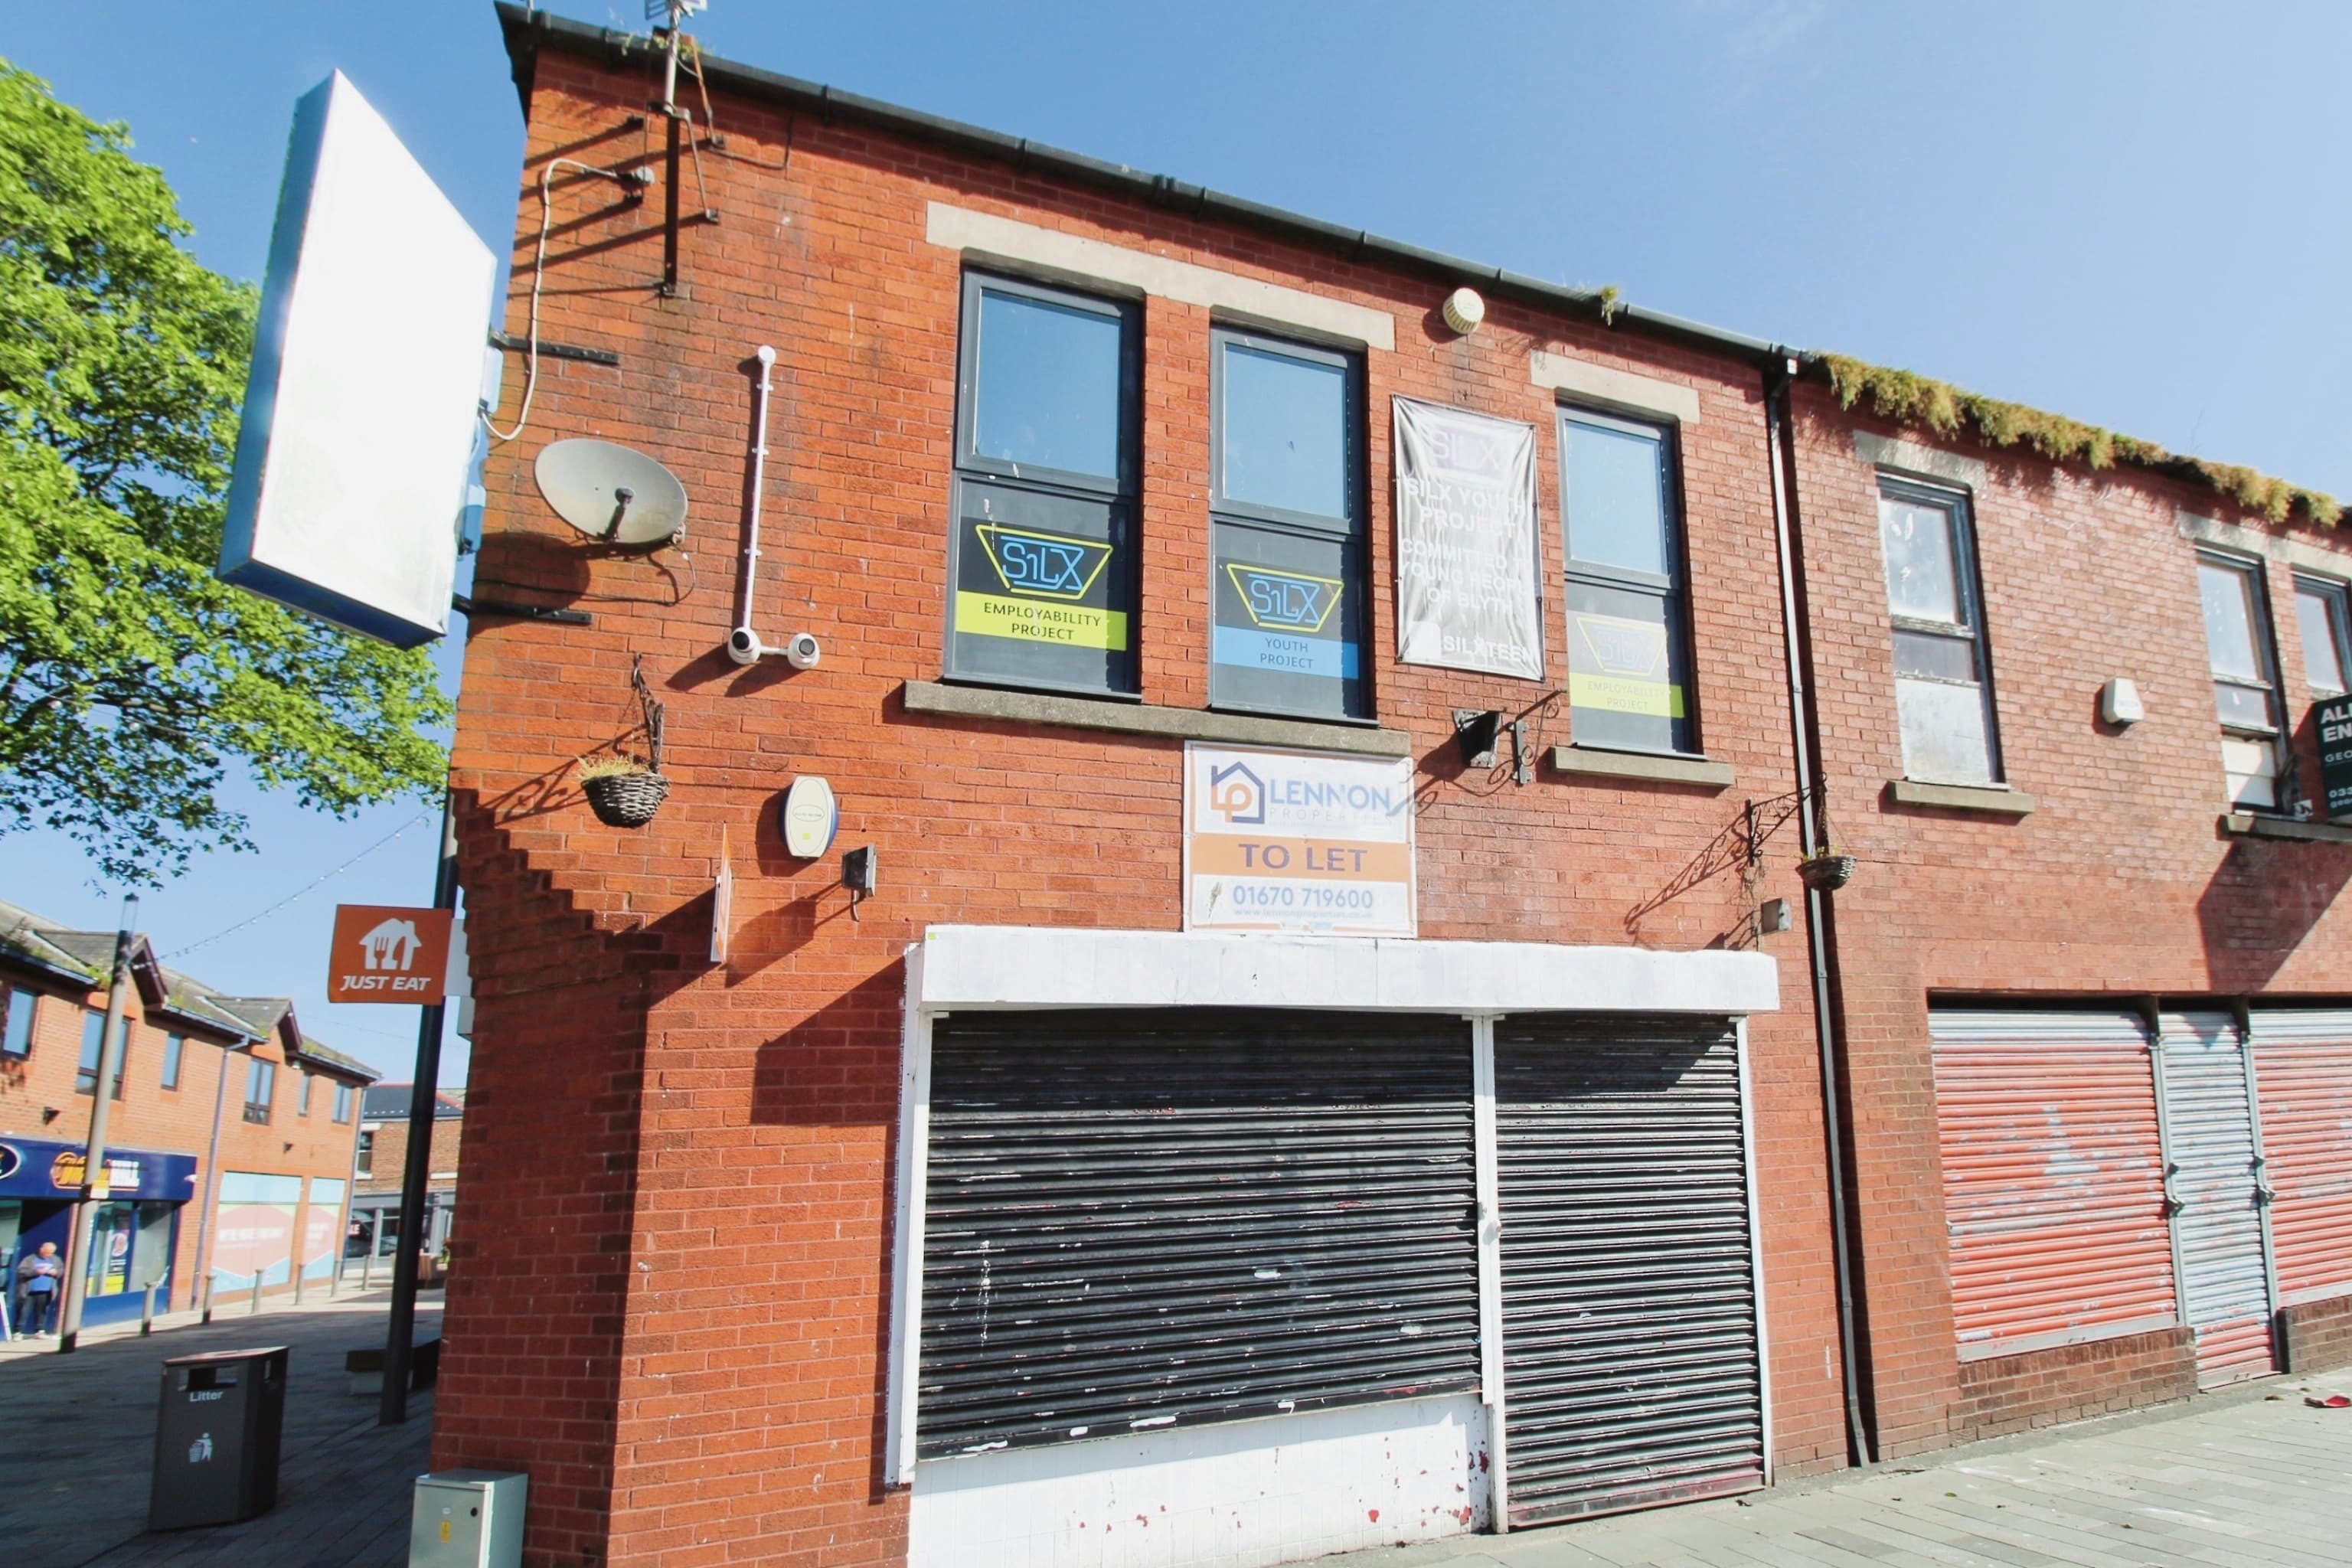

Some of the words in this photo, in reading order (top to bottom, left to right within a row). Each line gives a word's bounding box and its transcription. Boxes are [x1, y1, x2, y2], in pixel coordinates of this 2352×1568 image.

[1427, 587, 1452, 603] OF
[1457, 592, 1514, 615] BLYTH
[983, 603, 1101, 626] EMPLOYABILITY
[1011, 622, 1076, 641] PROJECT
[1265, 637, 1308, 654] YOUTH
[1259, 652, 1315, 669] PROJECT
[1607, 697, 1648, 711] PROJECT
[1270, 777, 1390, 810] LENNON
[1238, 843, 1291, 869] TO
[1305, 846, 1369, 873] LET
[1233, 884, 1294, 906] 01670
[1301, 887, 1374, 909] 719600
[339, 975, 390, 992] JUST
[392, 976, 433, 991] EAT
[188, 1390, 224, 1403] Litter
